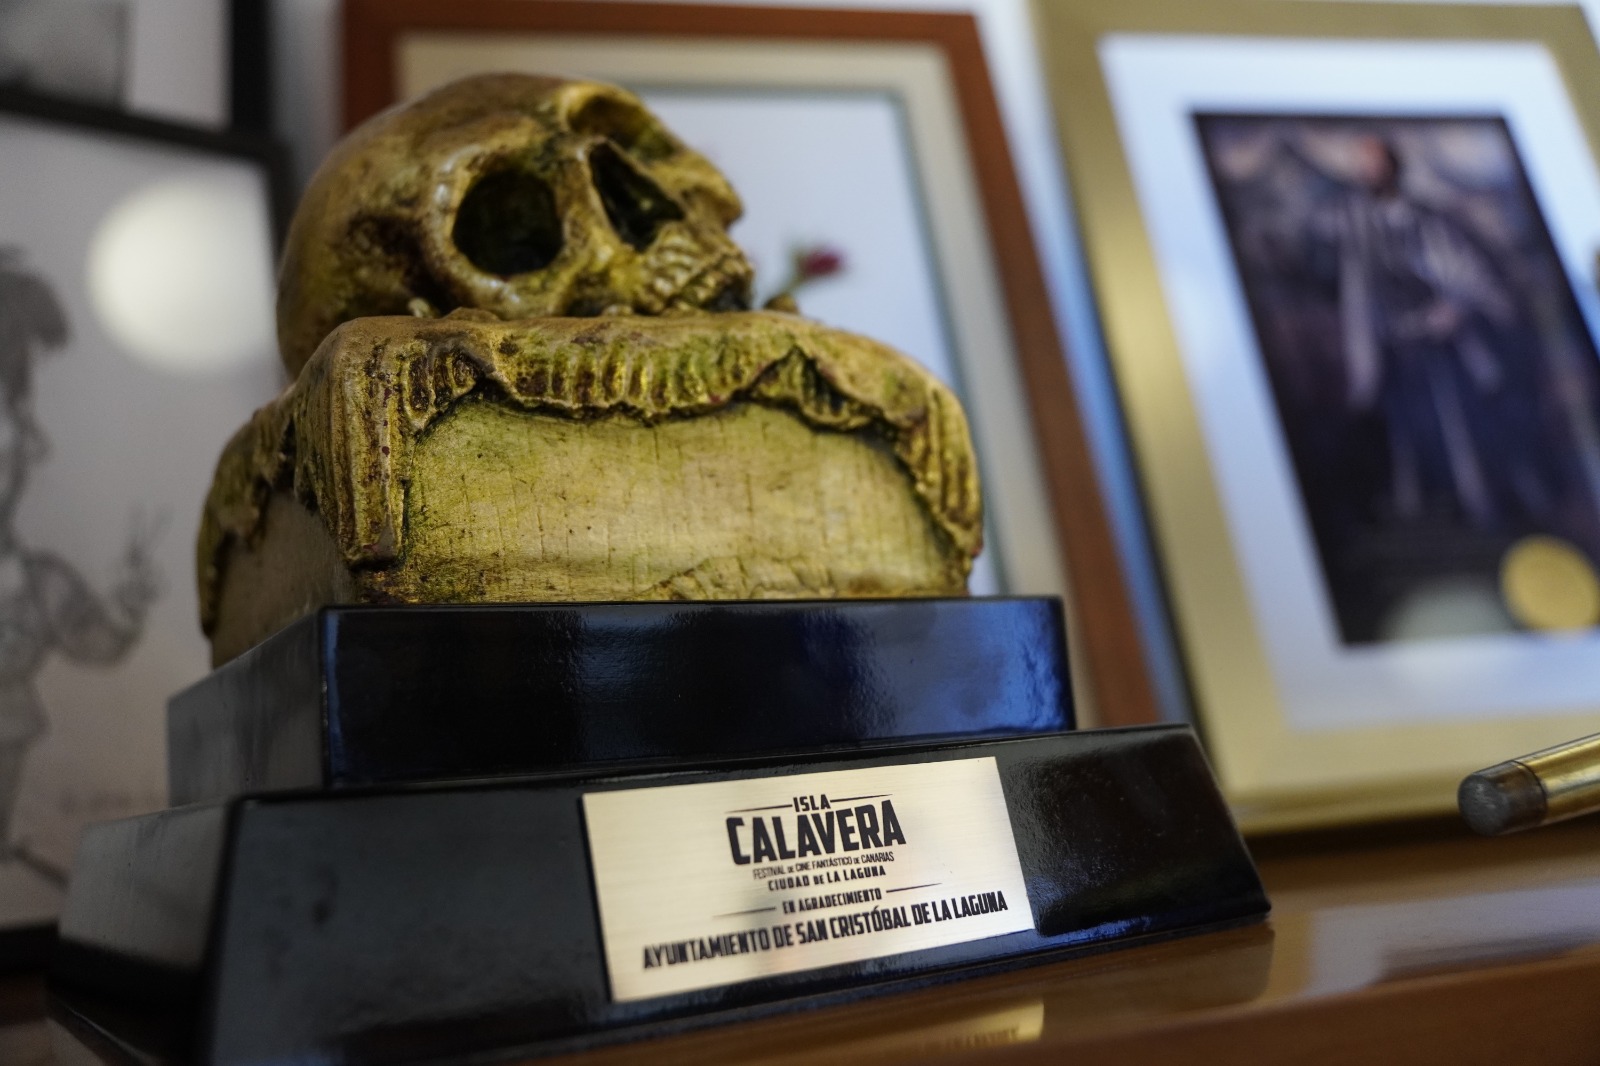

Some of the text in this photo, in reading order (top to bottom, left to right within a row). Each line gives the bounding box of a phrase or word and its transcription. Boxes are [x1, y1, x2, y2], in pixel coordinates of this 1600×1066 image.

[793, 794, 831, 812] ISLA
[726, 800, 906, 865] CALAVERA
[753, 865, 786, 880] FESTIVAL
[795, 862, 810, 872] CINE
[812, 857, 853, 870] FANTÁSTICO
[861, 851, 895, 864] CANARIAS
[768, 865, 886, 891] CIUDAD DE LA LAGUNA
[782, 887, 883, 914] EN AGRADECIMIENTO
[643, 890, 1009, 969] AYUNTAMIENTO DE SAN CRISTÓBAL DE LA LAGUNA
